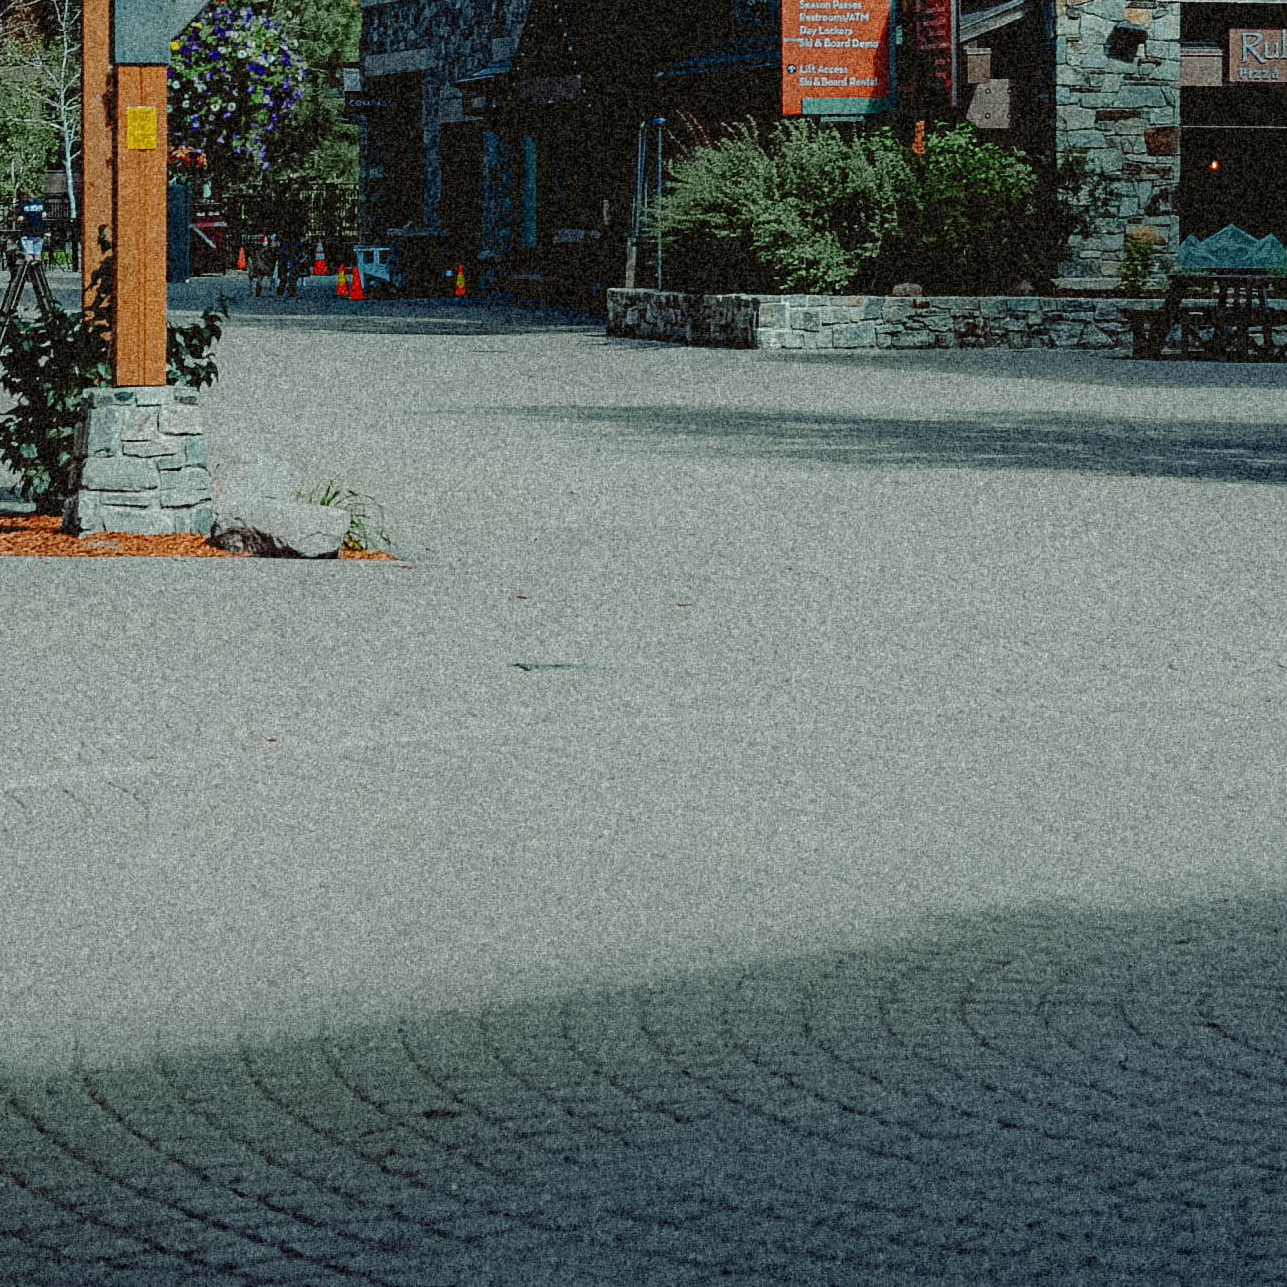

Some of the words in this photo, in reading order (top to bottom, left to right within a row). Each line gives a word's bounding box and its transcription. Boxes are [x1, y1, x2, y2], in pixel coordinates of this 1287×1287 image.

[799, 0, 831, 10] Season
[833, 0, 862, 10] Passes
[799, 12, 870, 23] Restrooms/ATM
[799, 25, 816, 37] Day
[818, 25, 854, 36] Lockers
[824, 37, 850, 48] Board
[852, 37, 880, 49] Demo
[799, 63, 815, 74] Lift
[817, 64, 849, 74] Access
[1239, 65, 1281, 81] Pizza
[821, 76, 847, 87] Board
[849, 76, 878, 87] Rental
